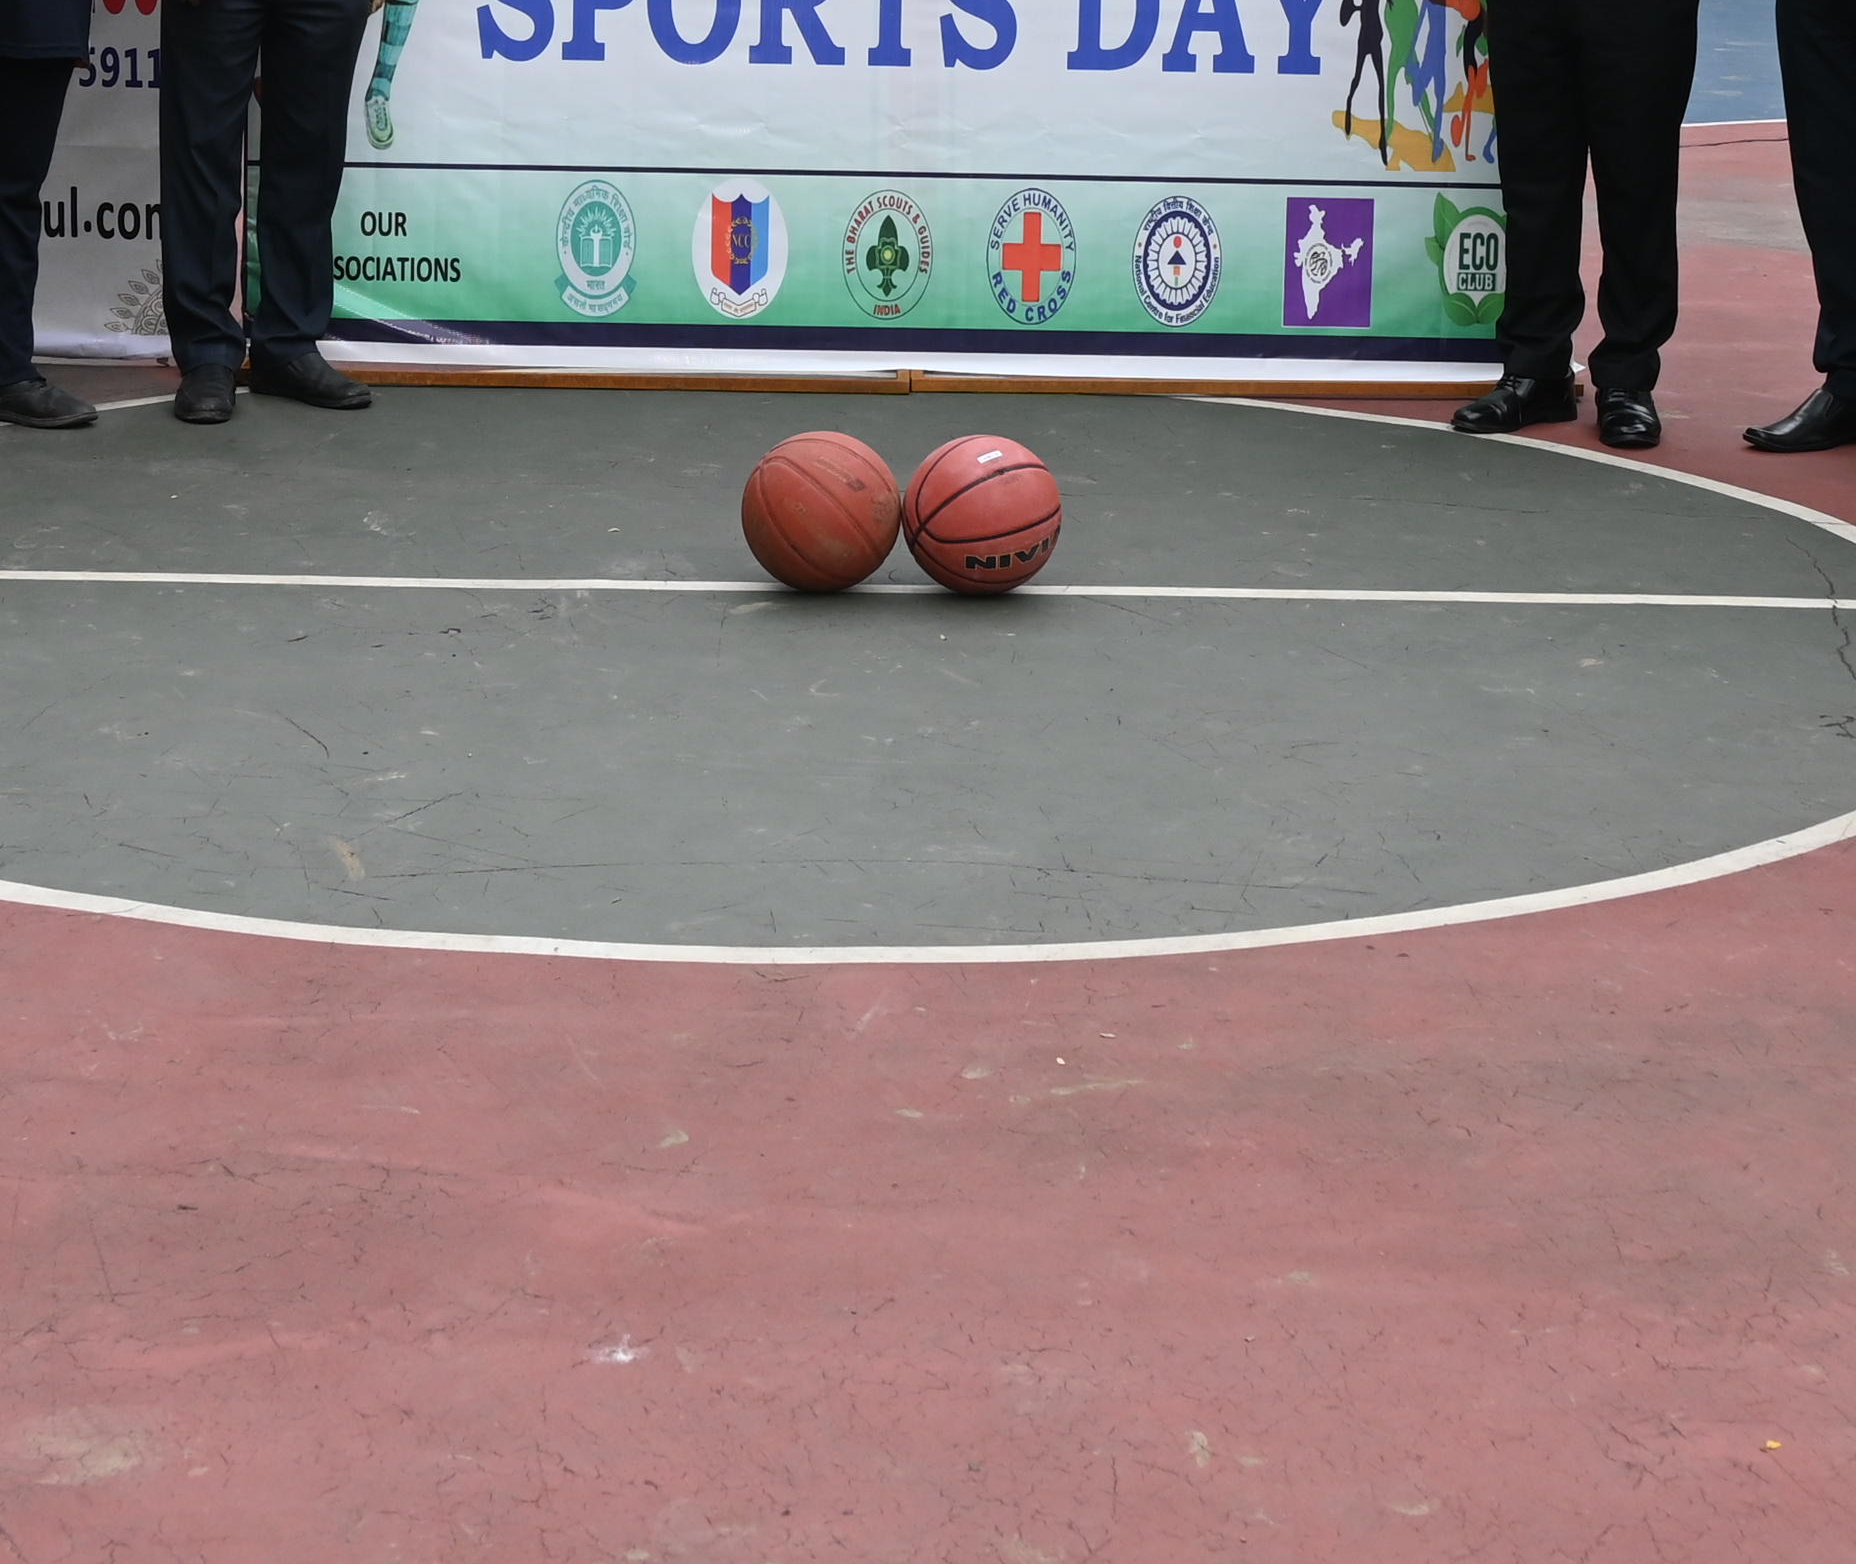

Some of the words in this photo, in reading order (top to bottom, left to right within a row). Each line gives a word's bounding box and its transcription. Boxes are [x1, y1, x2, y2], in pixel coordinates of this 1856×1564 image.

[847, 200, 874, 244] BHARAT
[877, 195, 913, 216] SCOUTS
[912, 213, 922, 224] &
[360, 211, 408, 237] OUR
[990, 198, 1021, 251] SERVE
[1023, 193, 1075, 252] HUMANITY
[845, 249, 856, 274] THE
[917, 225, 930, 274] GUIDES
[1458, 232, 1499, 271] ECO
[333, 255, 462, 283] SOCIATIONS
[1458, 273, 1494, 291] CLUB
[992, 271, 1016, 314] RED
[1025, 270, 1072, 322] CROSS
[1135, 254, 1147, 297] National
[1143, 294, 1164, 319] Centre
[1164, 311, 1175, 323] for
[1204, 256, 1220, 304] Education
[873, 304, 901, 316] INDIA
[965, 525, 1060, 569] NIVI
